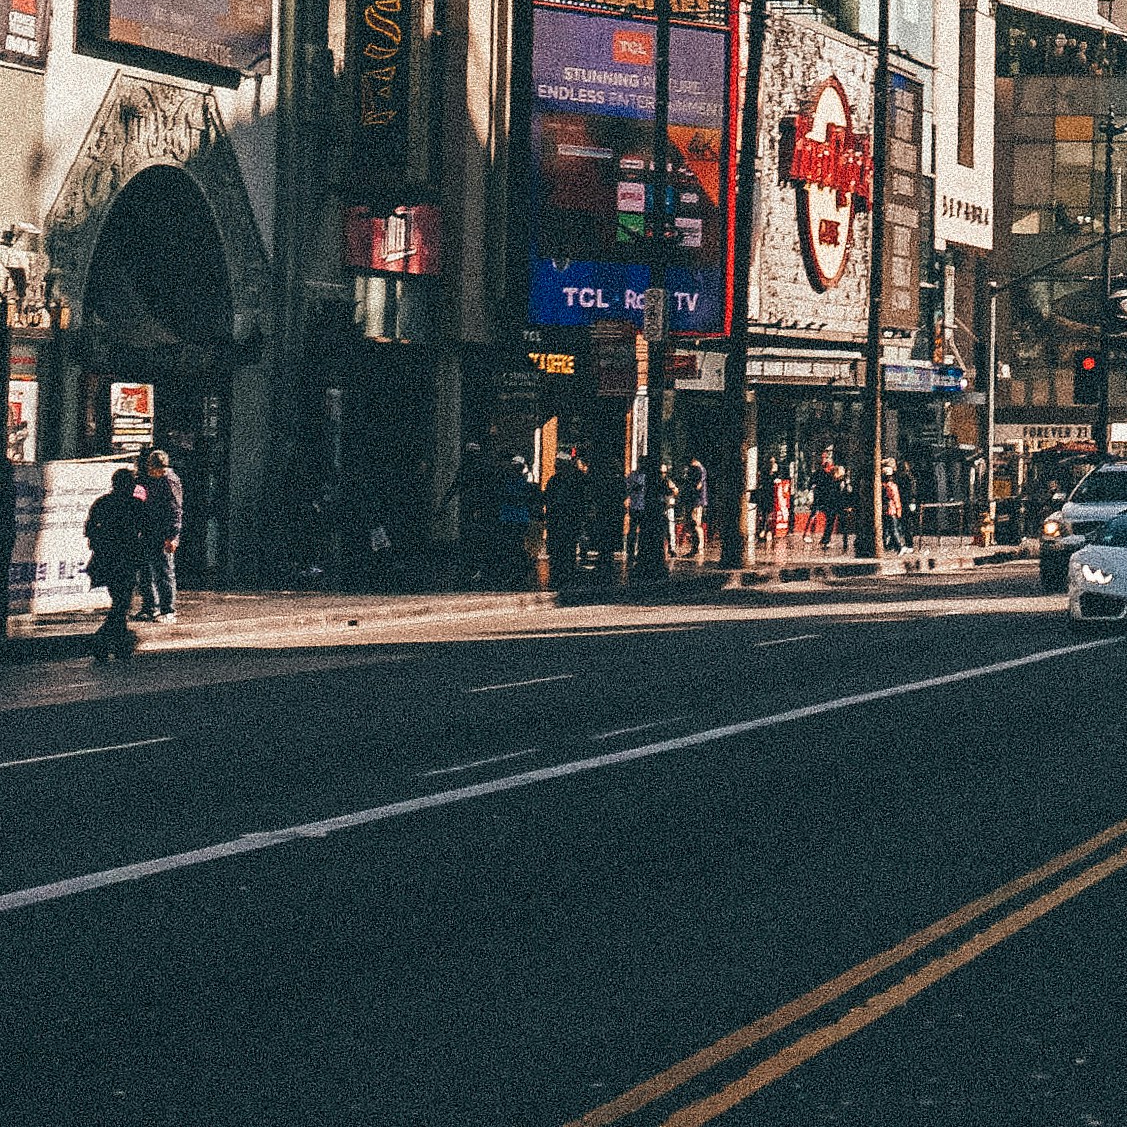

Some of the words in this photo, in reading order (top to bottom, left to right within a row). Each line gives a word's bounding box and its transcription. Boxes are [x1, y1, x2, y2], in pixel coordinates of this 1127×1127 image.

[563, 67, 639, 88] STUNNING
[643, 76, 705, 95] PIURE
[537, 84, 605, 105] ENDLESS
[563, 287, 609, 308] TCL
[674, 291, 700, 312] TV
[1023, 426, 1071, 438] FOREVER
